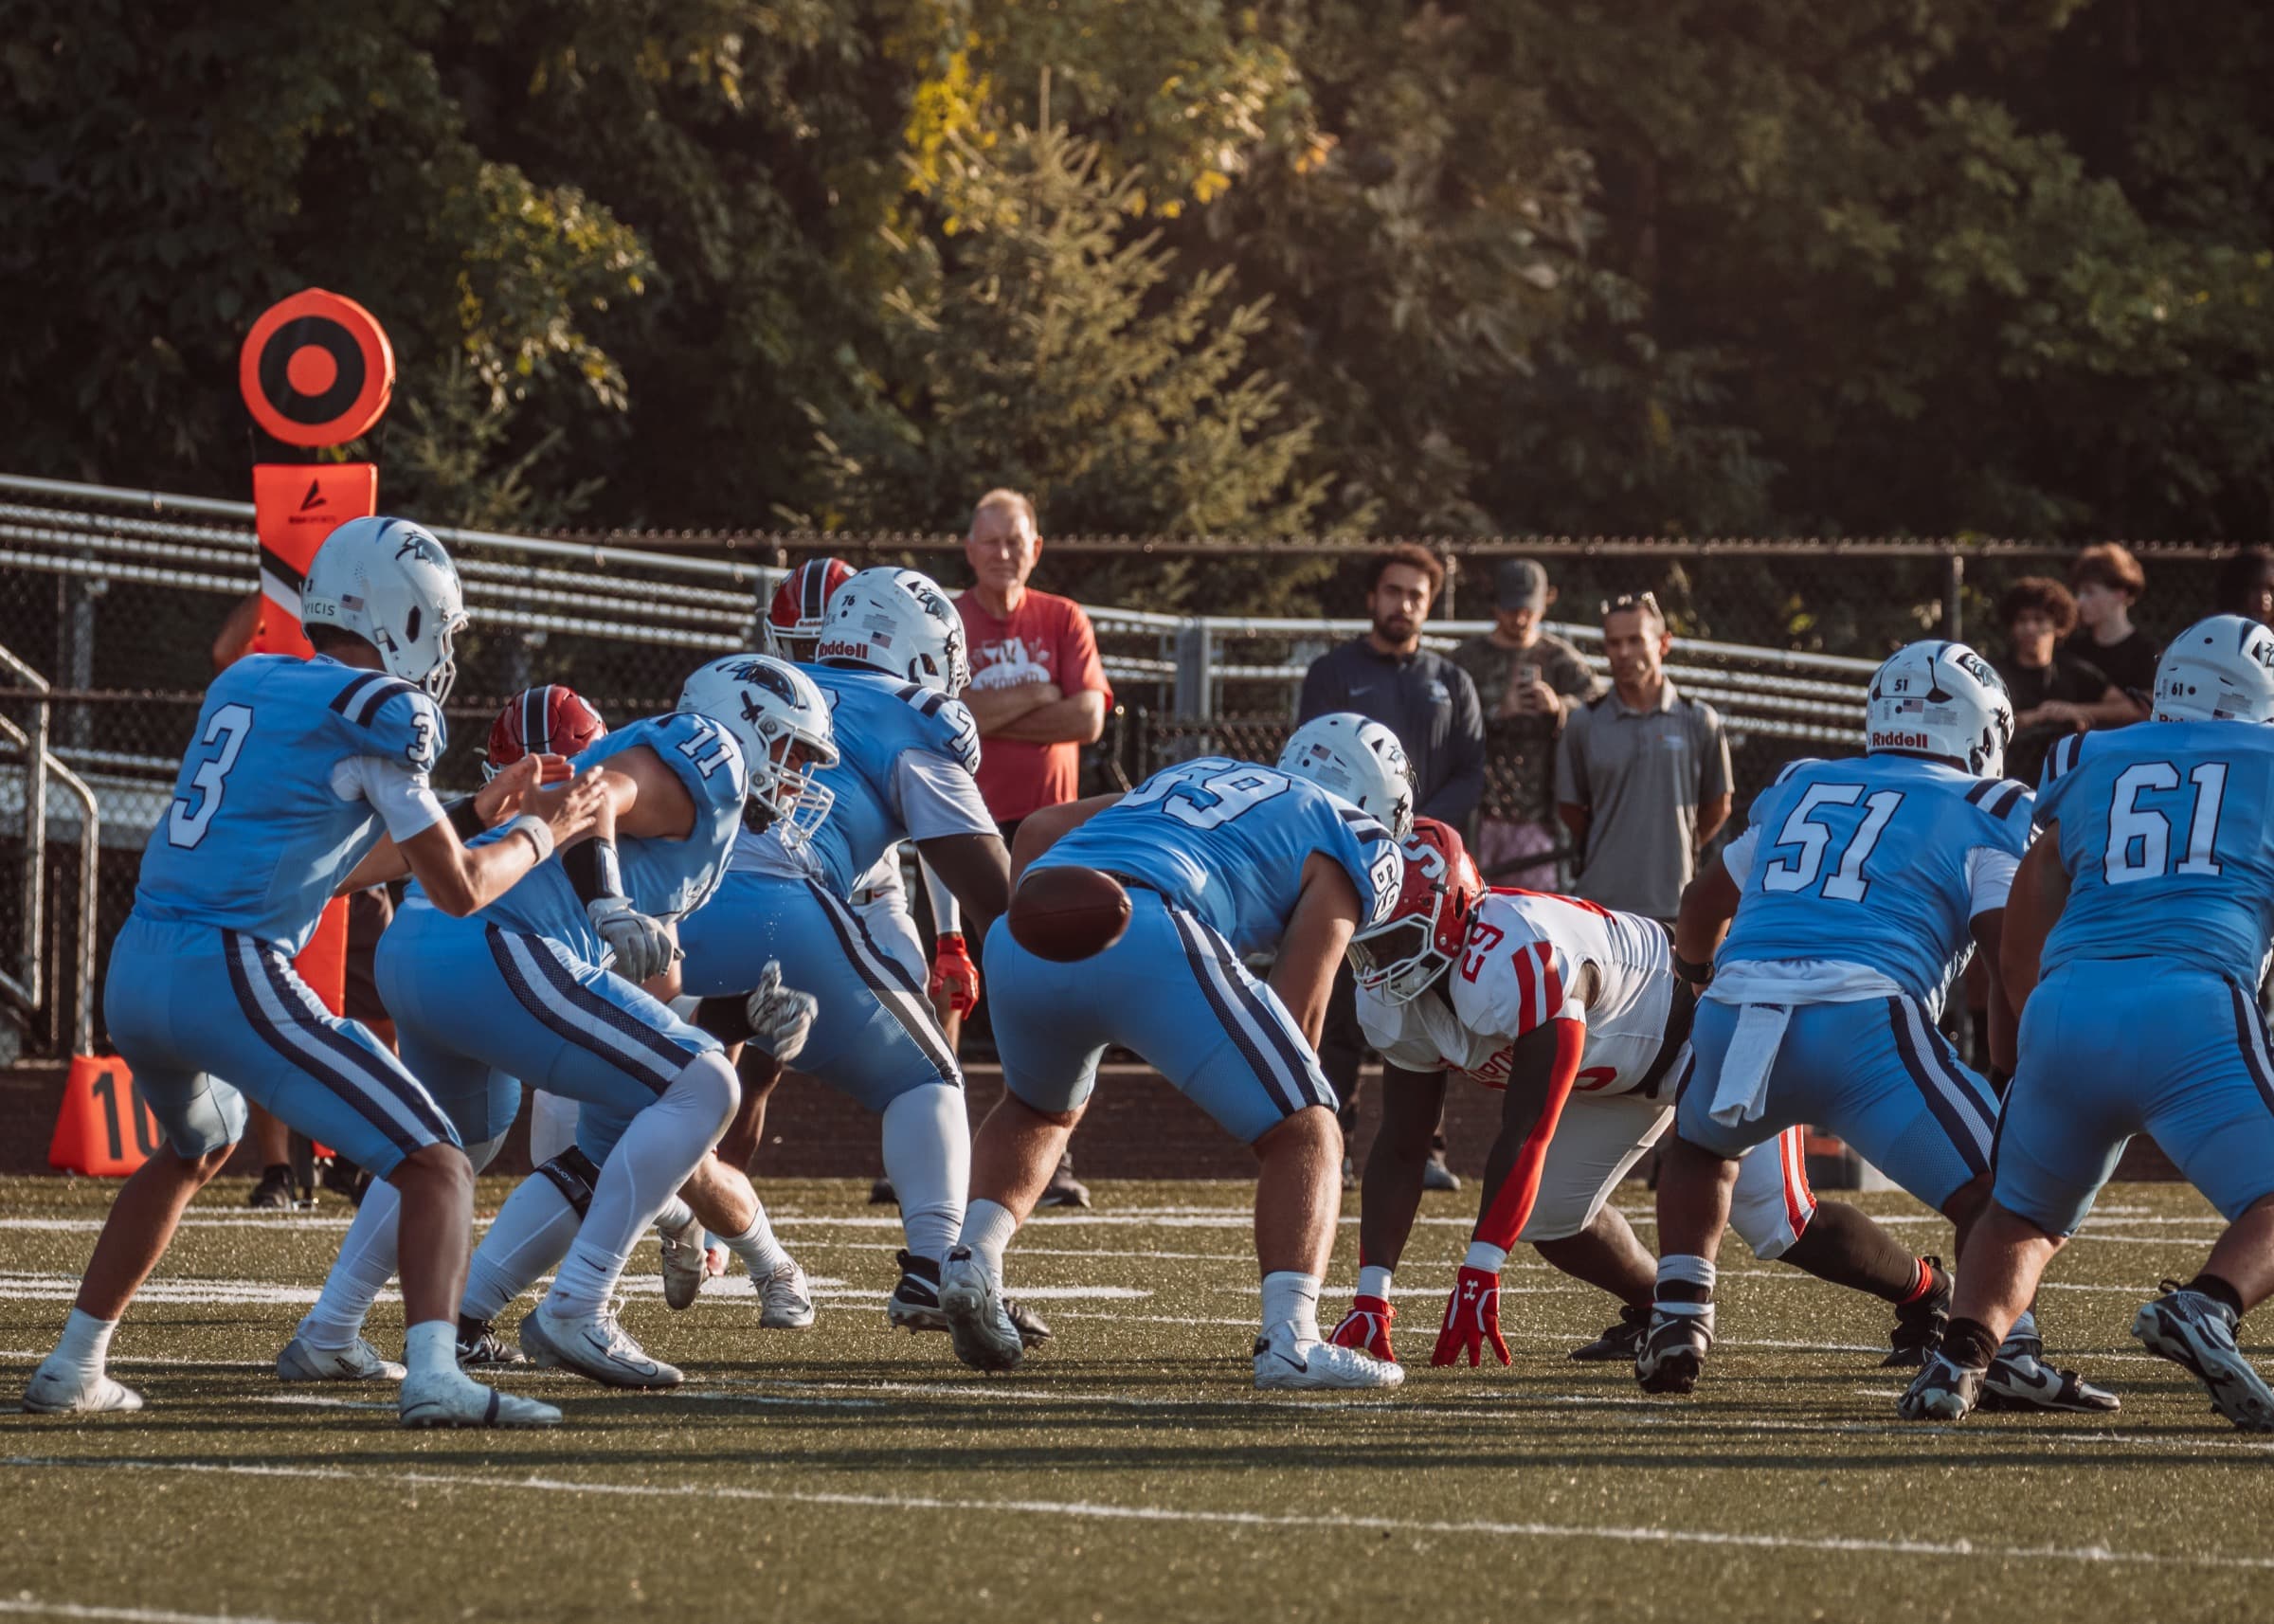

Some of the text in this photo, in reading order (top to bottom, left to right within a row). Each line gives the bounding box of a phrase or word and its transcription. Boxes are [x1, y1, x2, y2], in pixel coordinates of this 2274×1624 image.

[303, 602, 335, 616] VICIS
[841, 595, 856, 606] 76
[818, 641, 868, 659] Riddell
[1894, 678, 1908, 692] 51
[2171, 682, 2184, 696] 61
[406, 713, 435, 763] 3
[675, 727, 734, 781] 11
[1872, 731, 1927, 749] Riddell
[169, 702, 253, 850] 3
[2103, 761, 2231, 885] 61
[1763, 783, 1904, 903] 51
[1461, 922, 1505, 984] 29
